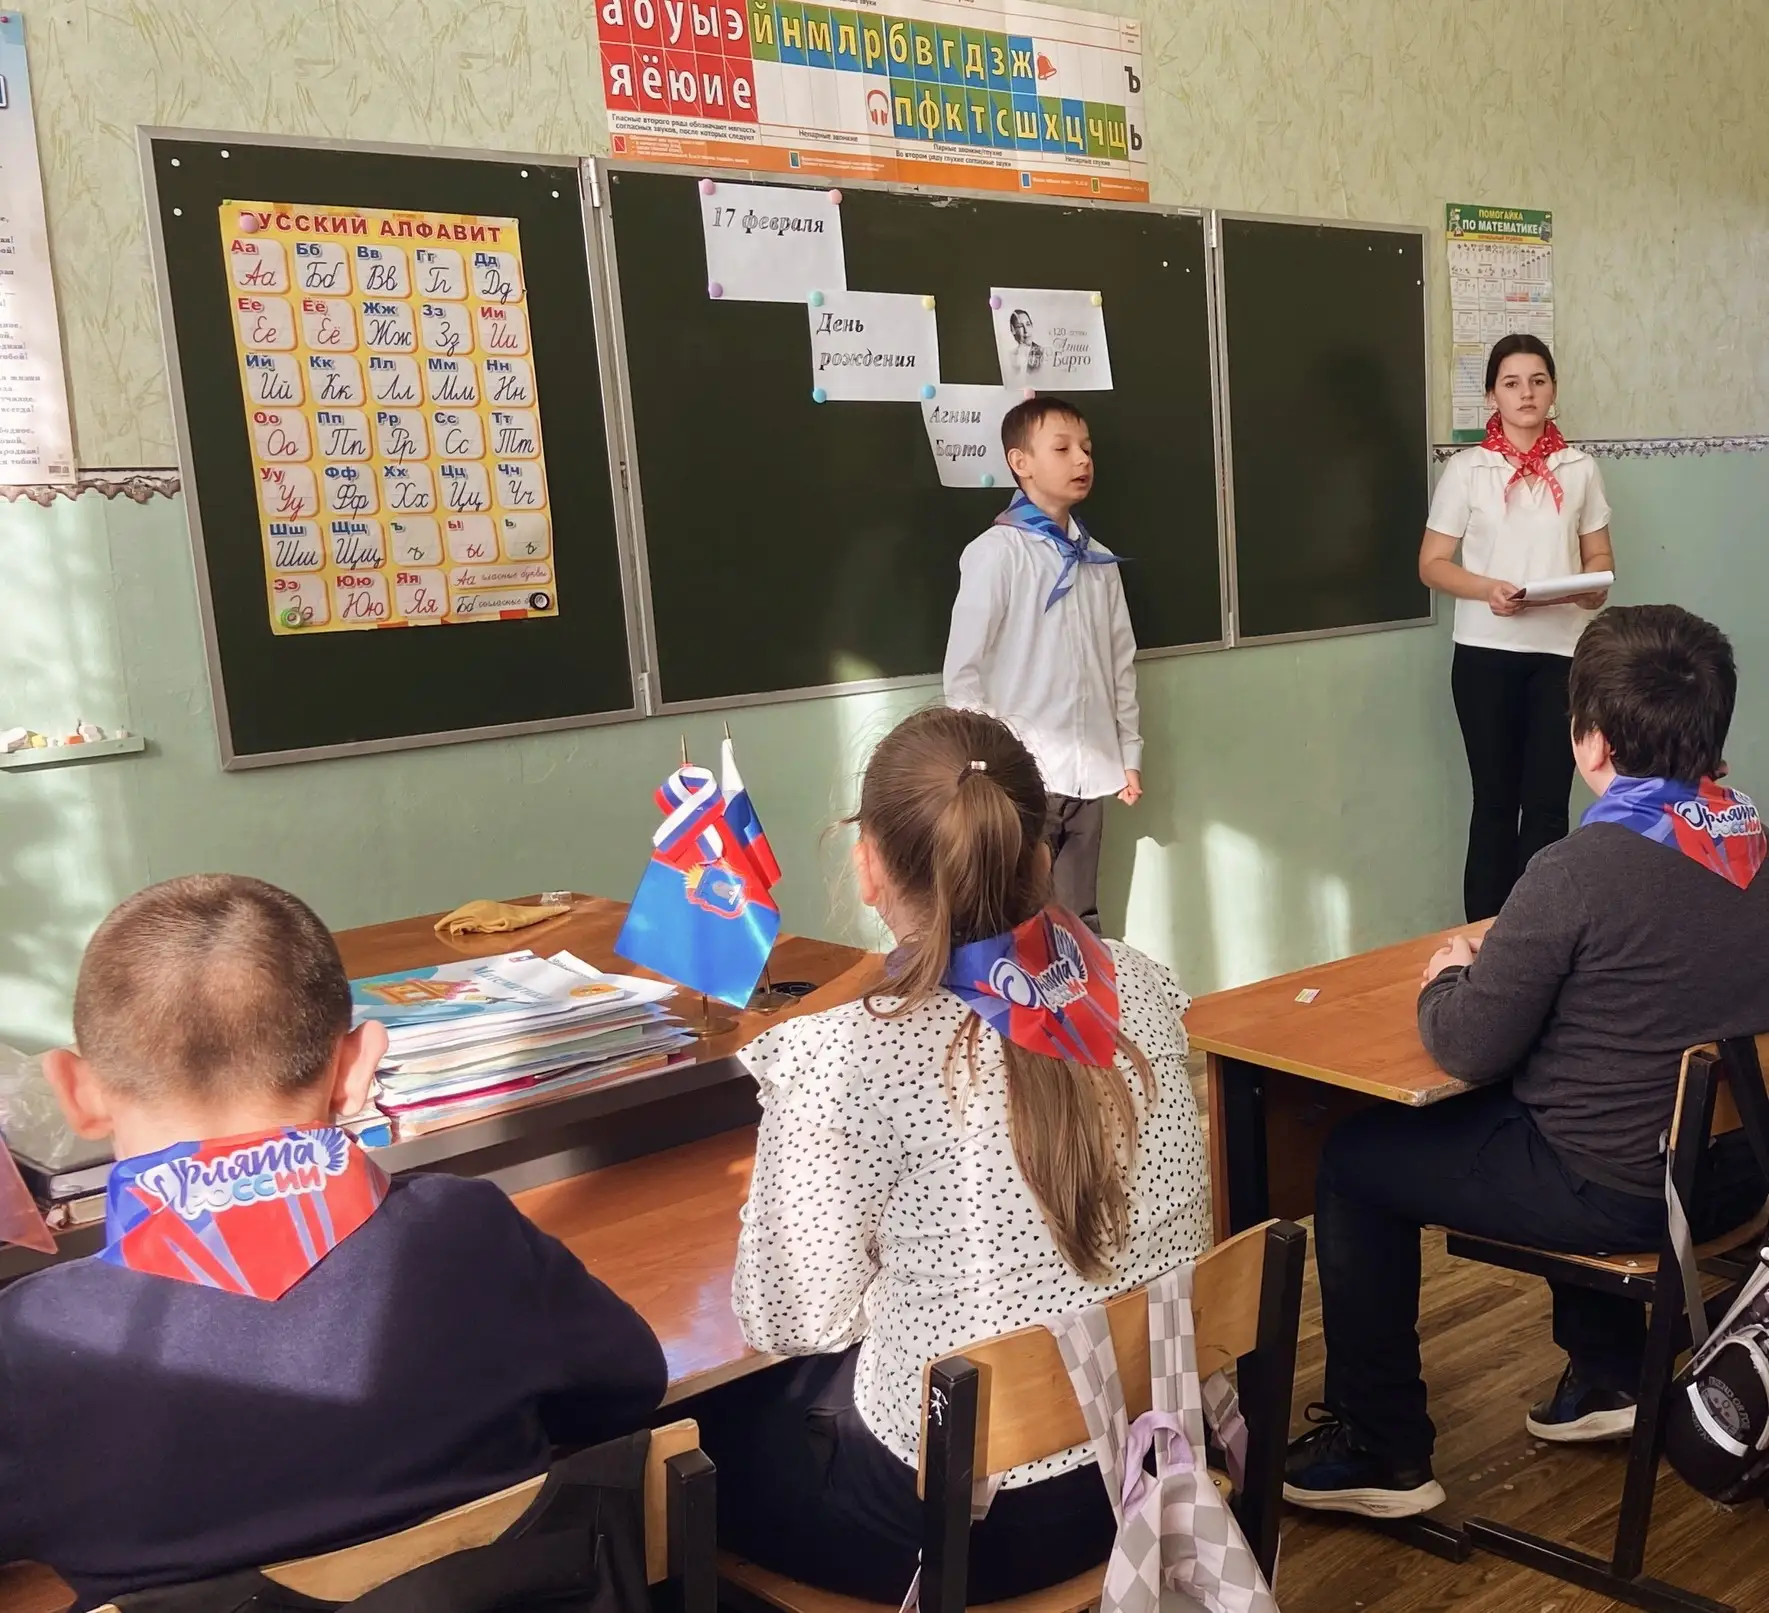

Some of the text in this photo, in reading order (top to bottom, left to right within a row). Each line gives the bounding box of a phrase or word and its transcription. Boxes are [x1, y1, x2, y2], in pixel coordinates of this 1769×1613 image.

[634, 0, 654, 30] о
[664, 1, 684, 45] у
[693, 3, 719, 38] ы
[727, 8, 743, 41] э
[753, 1, 1141, 94] й н м л р б в г д з ж ъ
[610, 54, 751, 109] я ё ю и е
[612, 113, 756, 134] Гласные второго ряда обозначают мягкость
[616, 123, 652, 131] согласных
[654, 126, 678, 135] звуков,
[700, 130, 728, 139] которых
[894, 90, 1143, 154] п ф к т с ш х ц ч щ ь
[799, 129, 859, 142] Непарные звонкие
[896, 149, 904, 158] Во
[905, 151, 928, 160] втором
[928, 154, 943, 162] ряду
[966, 157, 995, 165] согласные
[933, 143, 957, 153] Парные
[1065, 156, 1111, 167] Непарные глухие
[712, 206, 825, 236] 17 февраля
[1478, 209, 1524, 221] ПОМОГАЙКА
[380, 220, 502, 243] АЛФАВИТ
[1462, 219, 1539, 234] ПО МАТЕМАТИКЕ
[231, 240, 500, 268] Аа Бб Вв Гг Дд
[239, 259, 512, 304] Аа Бб Вв Гг Дд
[238, 297, 504, 319] Ее Ёё Жж Зз Ии
[816, 312, 865, 335] День
[252, 313, 518, 357] Ее Ёё Жж Зз Ии
[246, 352, 510, 372] Йй Кк Лл Мм Нн
[819, 347, 916, 371] рождения
[1053, 351, 1092, 373] Барто
[261, 373, 527, 401] Йй Кк Лл Мм Нн
[254, 411, 512, 426] Оо Пп Рр Сс Тт
[929, 405, 982, 424] Агнии
[267, 428, 535, 465] Оо Пп Рр Сс Тт
[935, 439, 987, 462] Барто
[260, 465, 520, 483] Уу Фф Хх Цц Чч
[276, 480, 536, 522] Уу Фф Хх Цц Чч
[270, 523, 305, 535] Шш
[332, 521, 368, 535] Щщ
[275, 540, 319, 568] Шш
[335, 537, 384, 570] Щщ
[274, 573, 421, 590] Ээ Юю Яя
[455, 568, 476, 586] Аа
[341, 591, 384, 620] Юю
[405, 588, 438, 614] Яя
[457, 595, 480, 614] Бб
